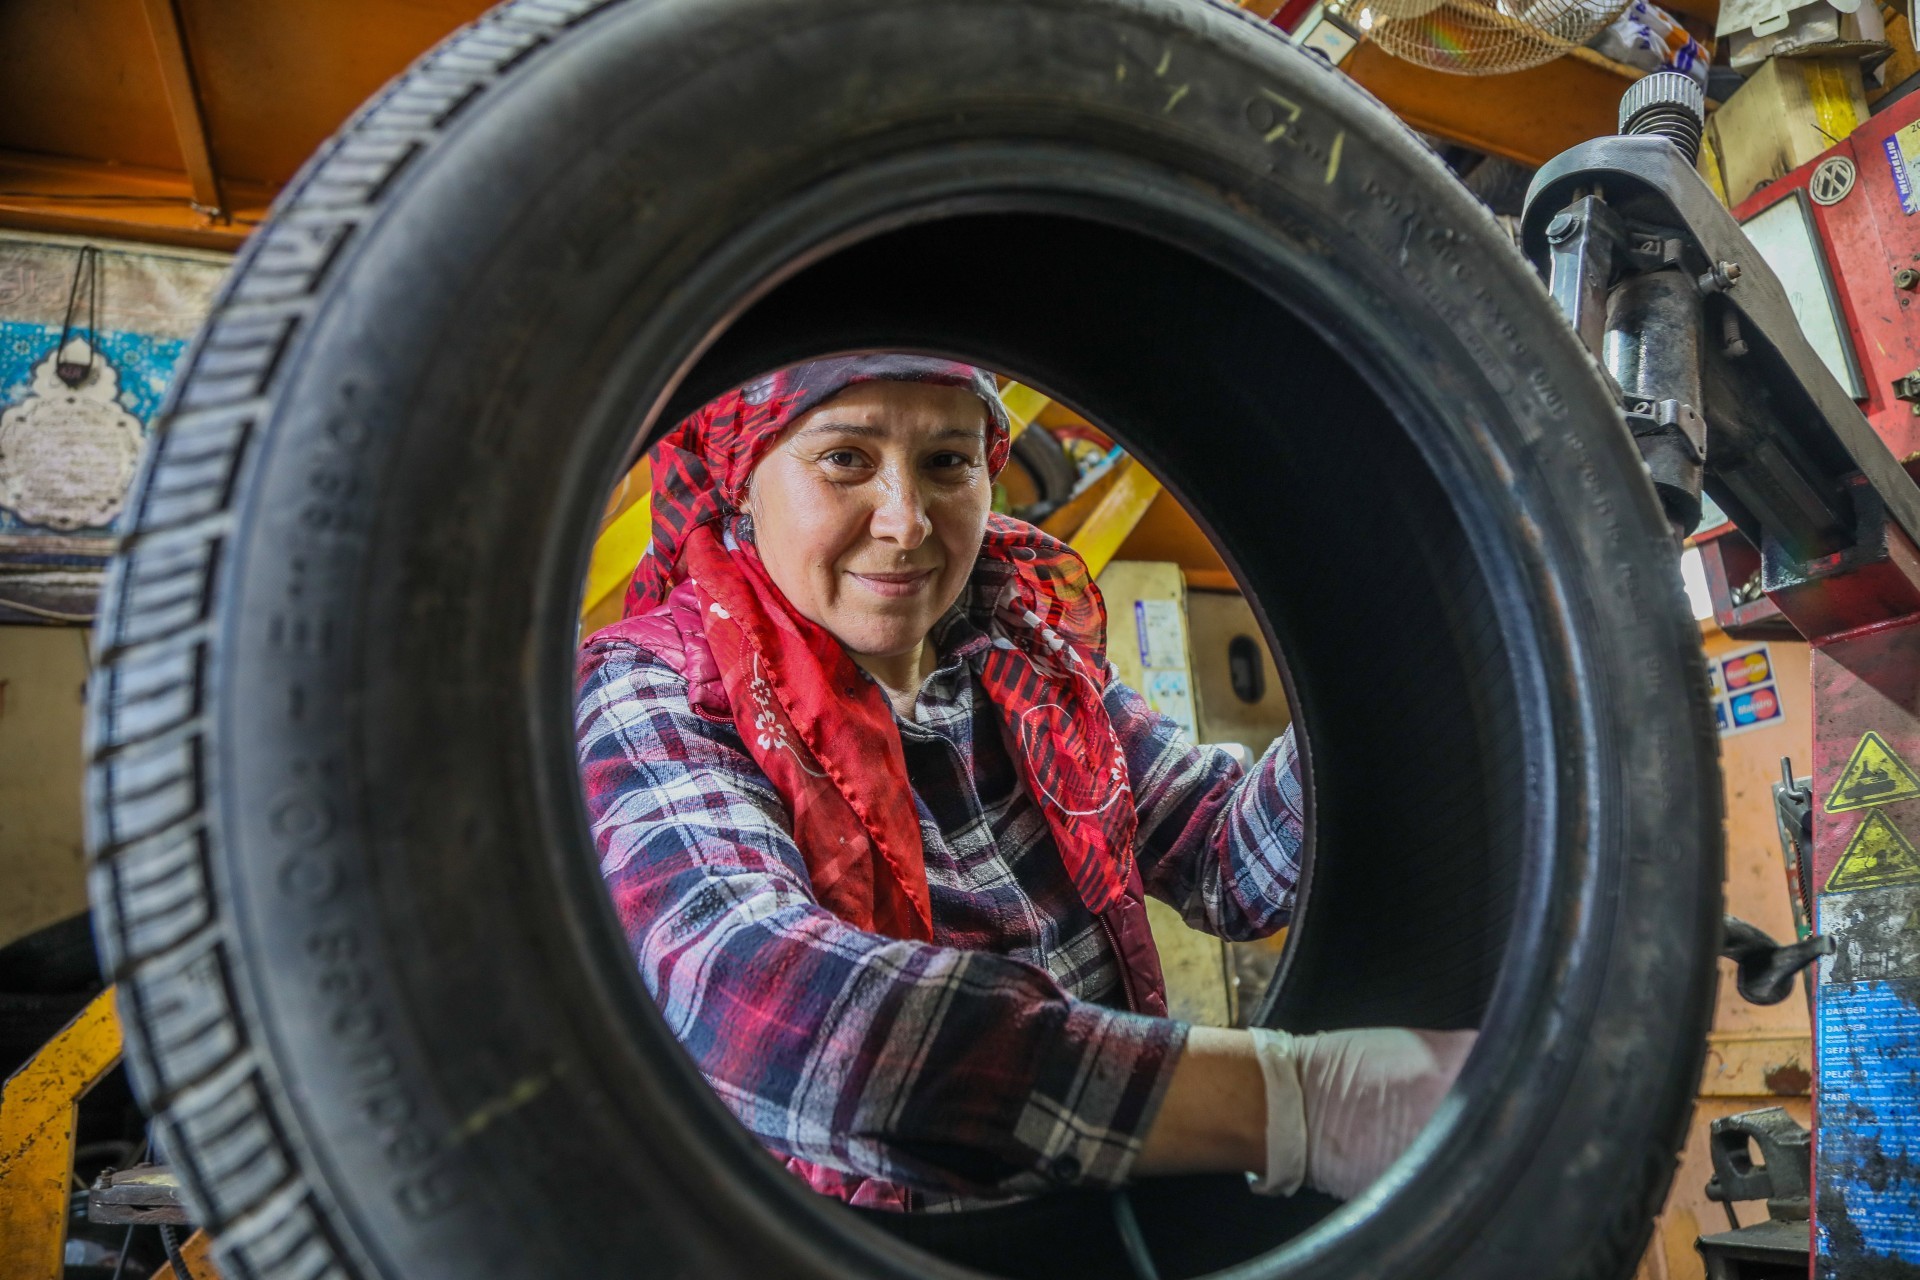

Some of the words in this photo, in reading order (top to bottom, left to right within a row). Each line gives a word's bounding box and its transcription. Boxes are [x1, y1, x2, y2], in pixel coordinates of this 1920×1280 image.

[1886, 141, 1909, 195] MICHELIN
[1727, 662, 1767, 680] MasterCard
[1738, 698, 1773, 715] Maestro
[1825, 1006, 1867, 1016] DANGER
[1825, 1024, 1867, 1033] DANGER
[1824, 1046, 1866, 1055] GEFAHR
[308, 926, 458, 1224] Reduces
[1824, 1069, 1869, 1079] PELIGRO
